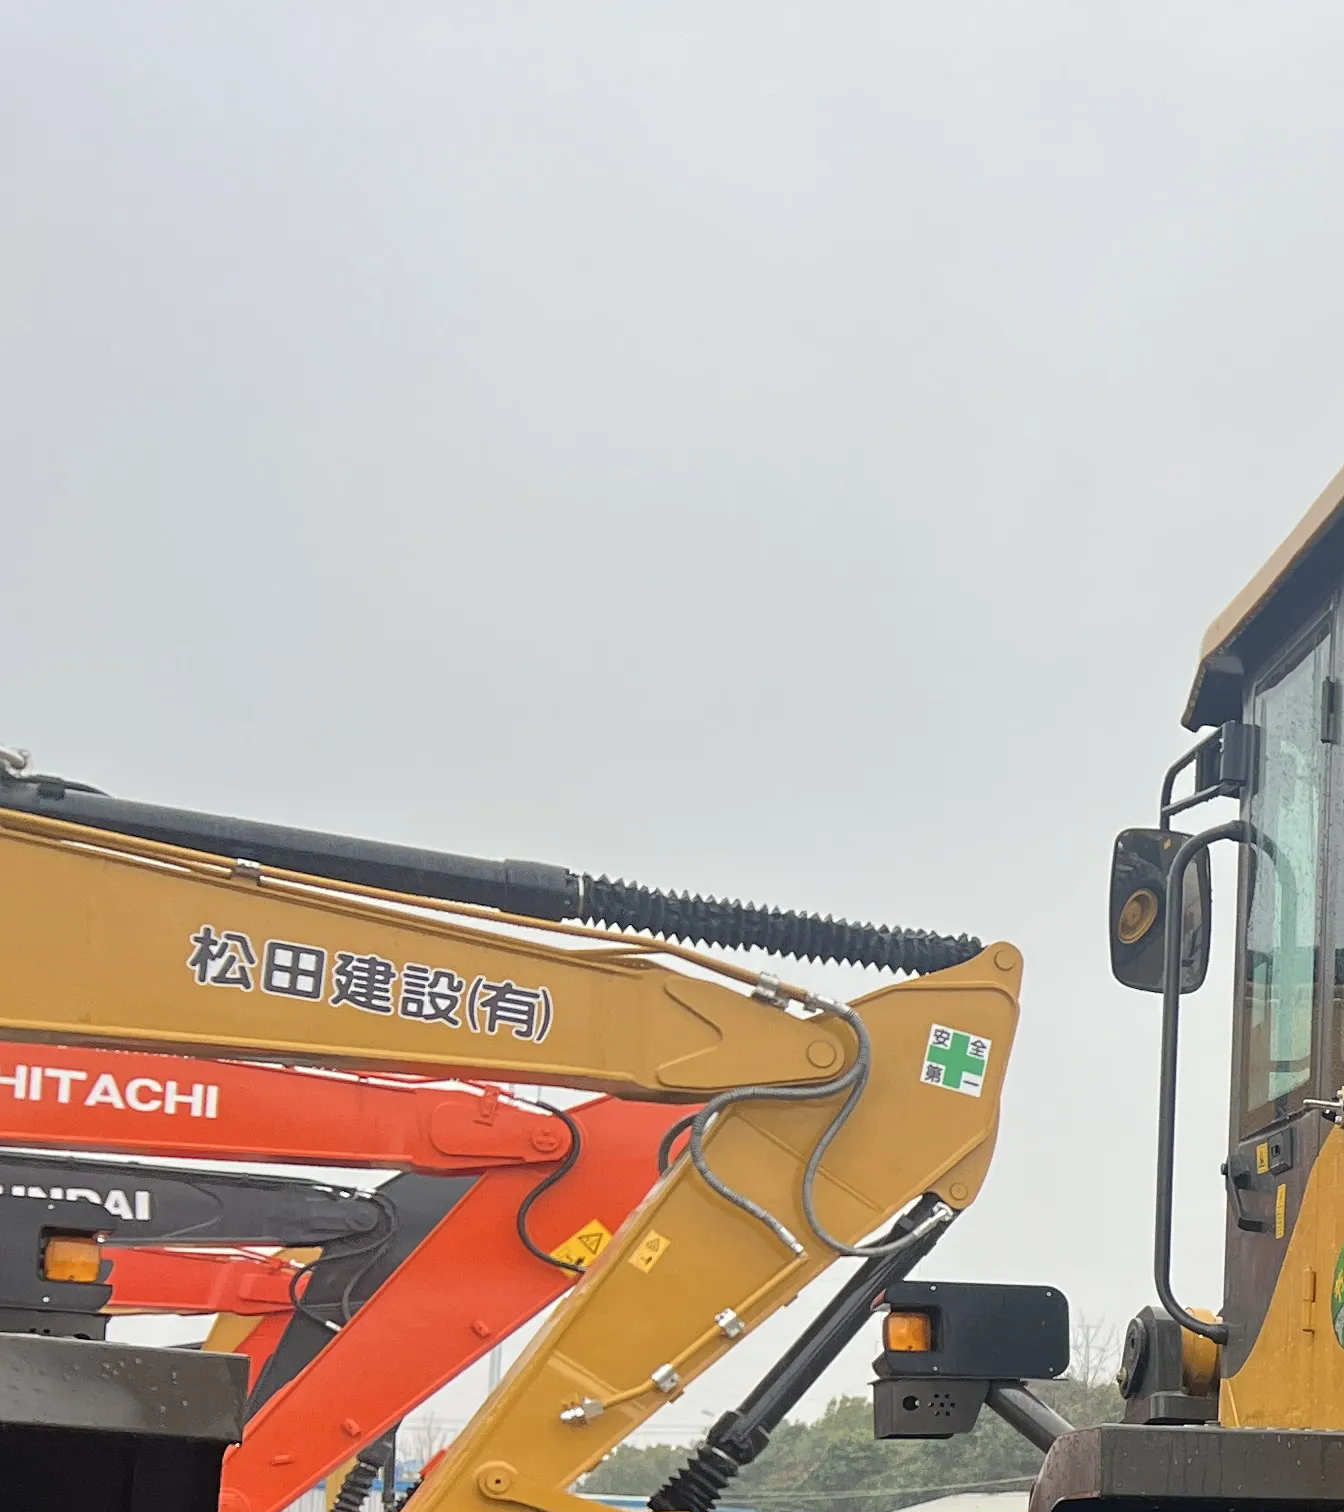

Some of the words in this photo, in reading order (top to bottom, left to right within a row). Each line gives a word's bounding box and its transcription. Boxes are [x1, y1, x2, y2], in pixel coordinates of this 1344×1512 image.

[187, 924, 554, 1043] 松田建設(有)
[0, 1064, 219, 1119] HITACHI
